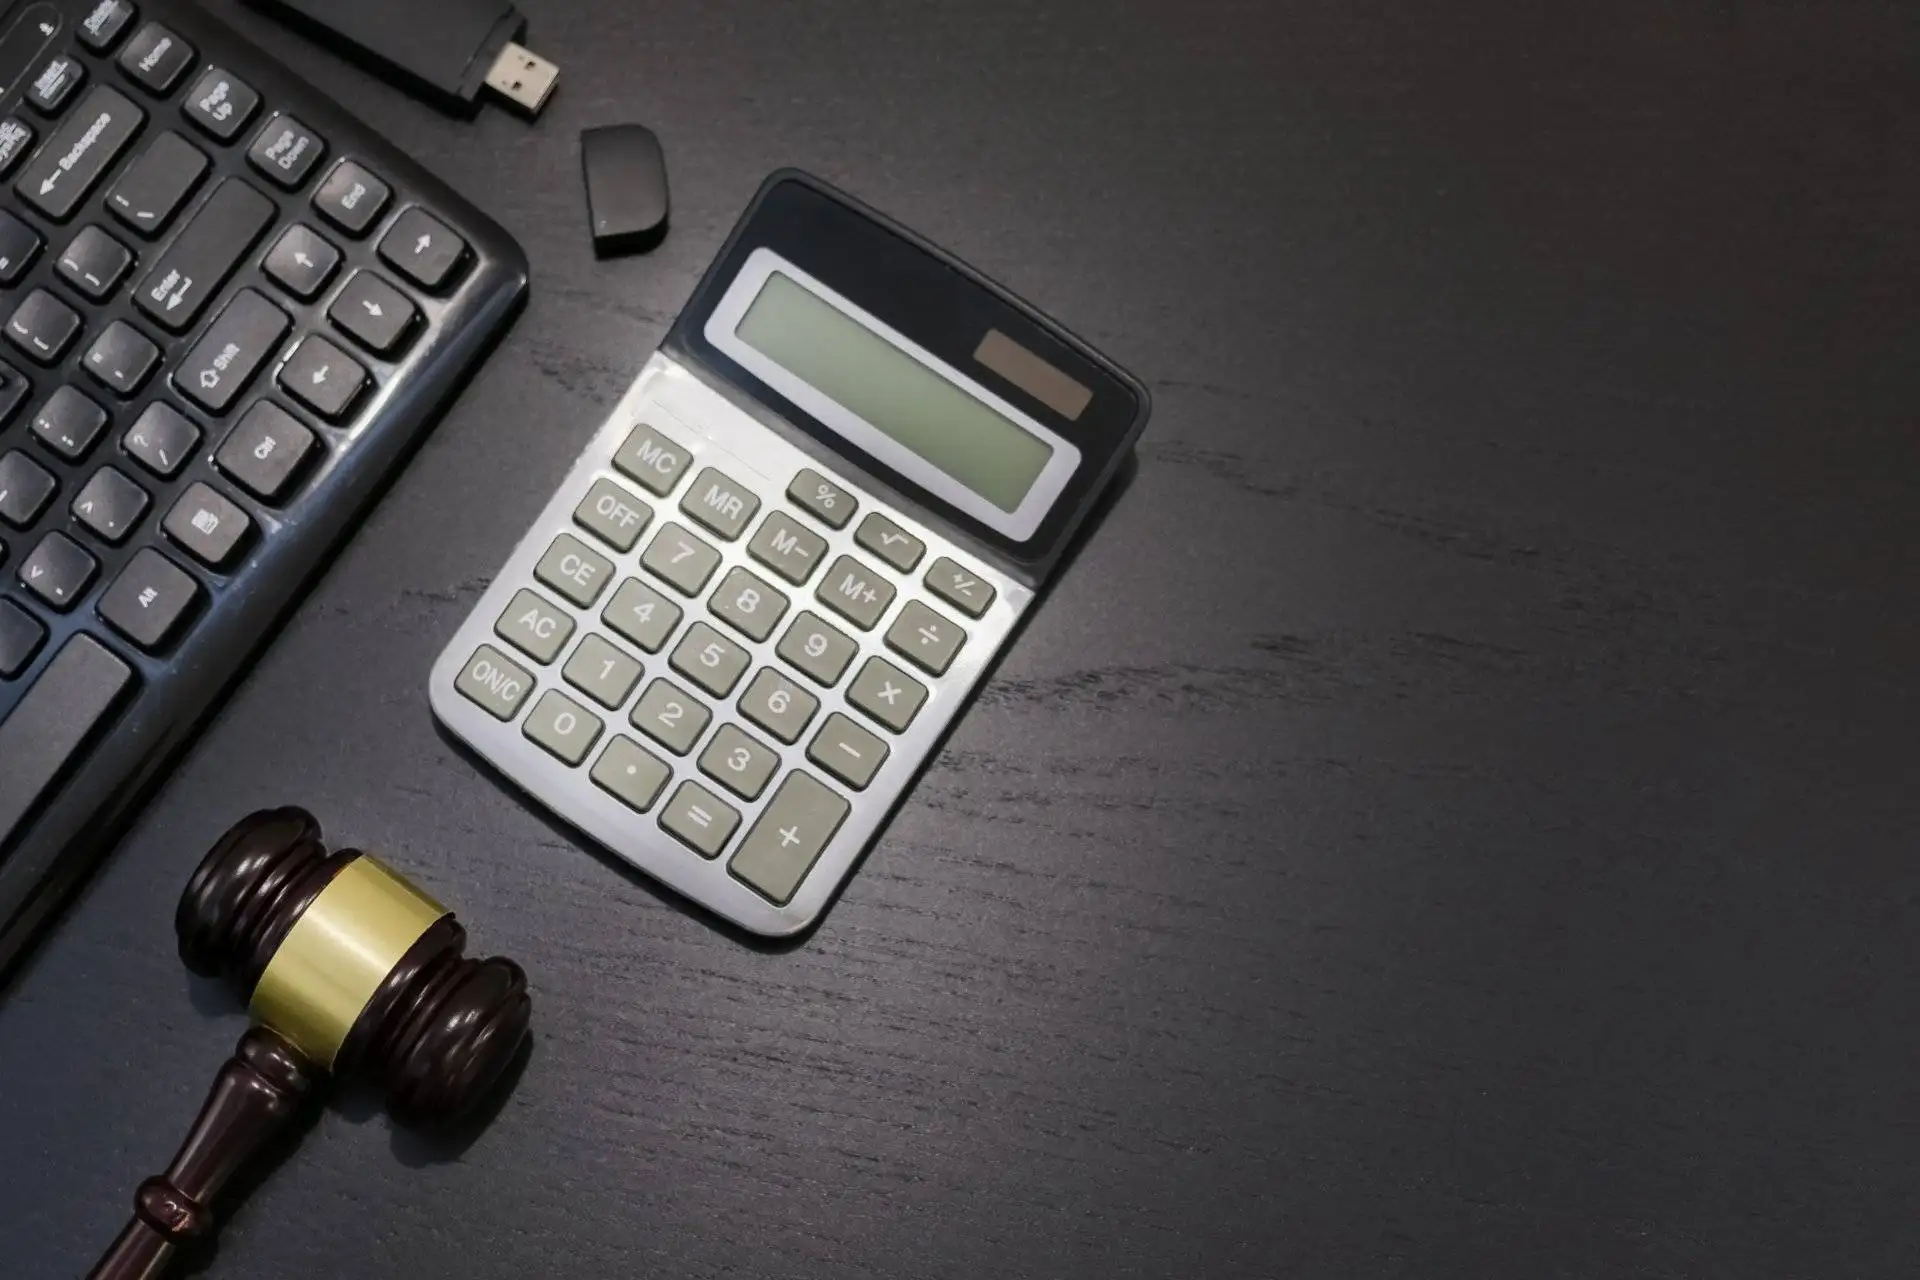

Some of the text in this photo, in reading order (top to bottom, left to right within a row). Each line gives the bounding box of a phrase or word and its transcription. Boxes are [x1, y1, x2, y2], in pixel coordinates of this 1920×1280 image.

[342, 183, 366, 209] End
[151, 269, 180, 301] Enter
[214, 343, 240, 370] Shift
[636, 440, 678, 474] MC
[704, 485, 743, 519] MR
[816, 485, 836, 508] %
[595, 496, 640, 529] OFF
[671, 542, 695, 564] 7
[559, 553, 596, 586] CE
[138, 587, 158, 607] Alt
[839, 574, 878, 603] M+
[632, 602, 655, 624] 4
[737, 589, 760, 613] 8
[518, 609, 556, 638] AC
[700, 643, 724, 667] 5
[805, 634, 827, 656] 9
[472, 660, 521, 702] ON/C
[600, 660, 615, 679] 1
[768, 689, 792, 713] 6
[554, 712, 576, 735] 0
[658, 702, 683, 727] 2
[728, 748, 750, 771] 3
[687, 805, 712, 827] =
[779, 826, 799, 847] +
